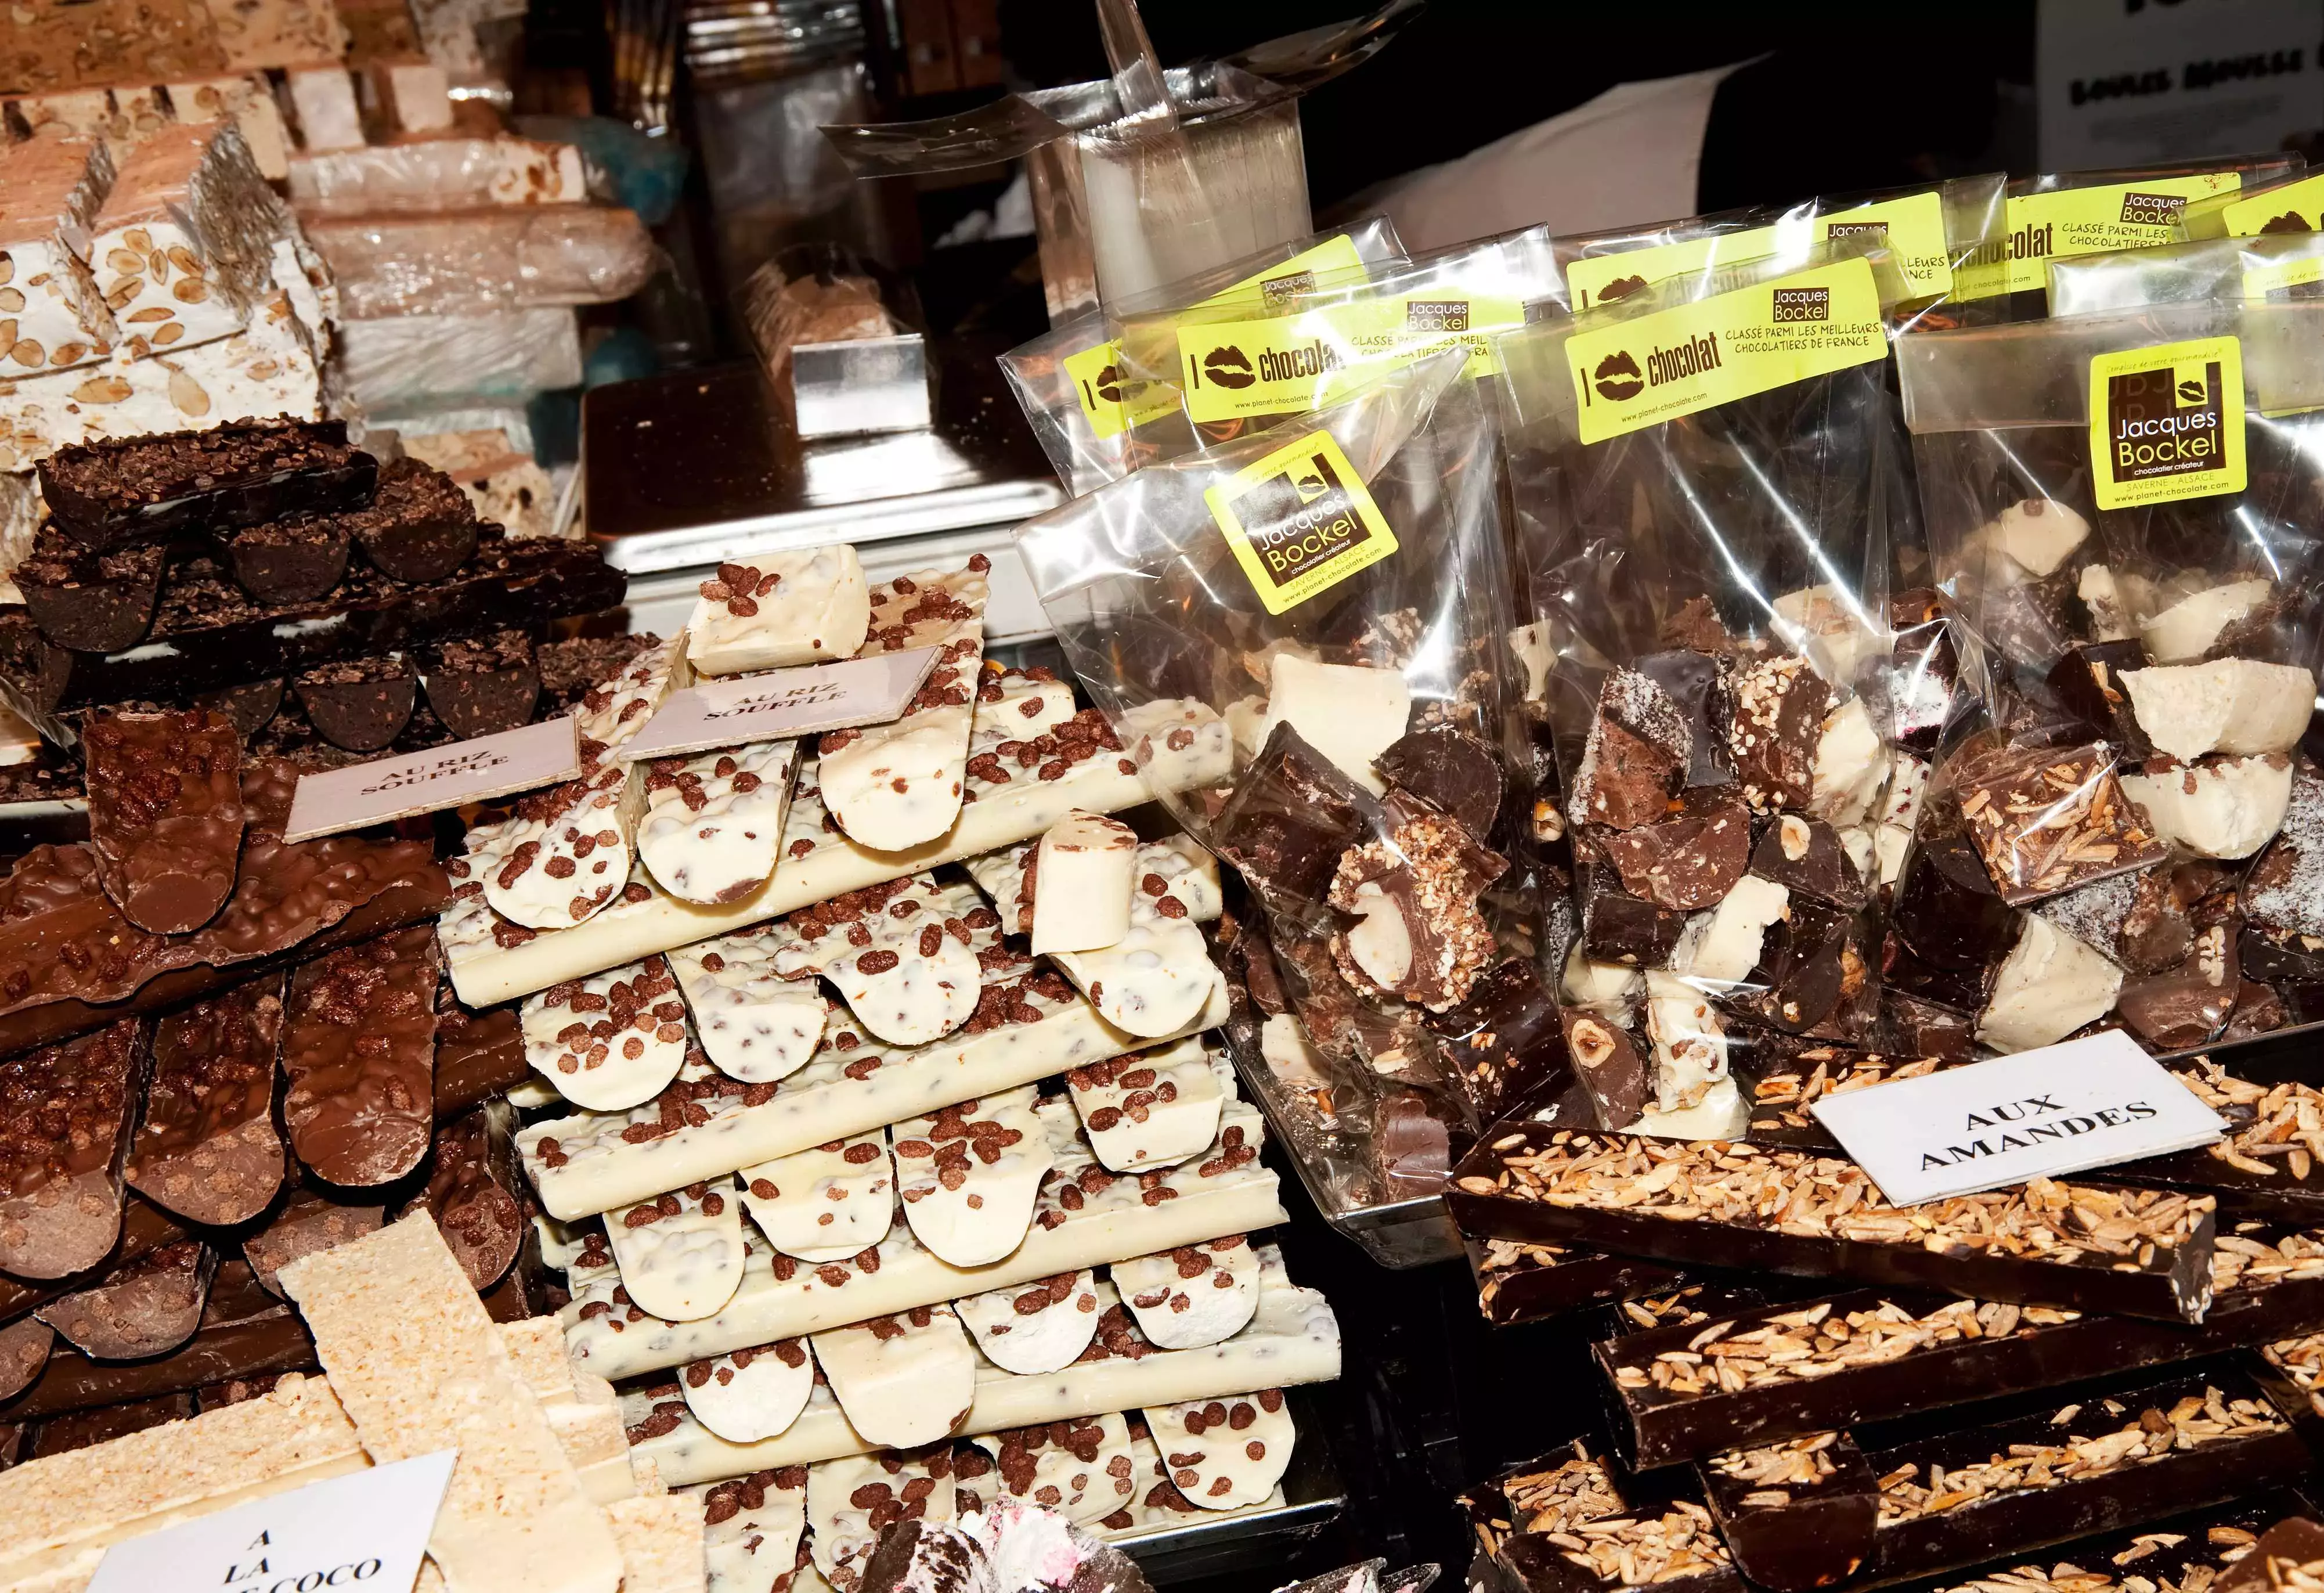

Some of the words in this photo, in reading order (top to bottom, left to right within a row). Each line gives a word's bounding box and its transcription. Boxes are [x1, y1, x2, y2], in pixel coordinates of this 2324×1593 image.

[2125, 193, 2185, 209] Jacques
[1829, 225, 1887, 237] Jacqus
[2062, 222, 2104, 234] CLASSÉ
[2108, 226, 2142, 236] PARMI
[2146, 229, 2167, 239] LES
[1908, 269, 1933, 279] NCE
[1775, 290, 1828, 304] Jacques
[1409, 303, 1467, 318] Jacques
[1409, 315, 1467, 330] Bockel
[1775, 302, 1827, 320] Bockel
[1460, 334, 1488, 345] MEIL
[1726, 325, 1762, 340] CLASSÉ
[1766, 326, 1793, 338] PARMI
[1799, 325, 1817, 336] LES
[1820, 322, 1879, 334] MEILLEURS
[1735, 339, 1807, 353] CHOCOLATIERS
[1811, 338, 1823, 348] DE
[1827, 336, 1870, 349] FRANCE
[1259, 339, 1347, 383] chocola
[1647, 331, 1722, 387] chocolat
[1235, 391, 1329, 409] www.planet-chocolate.cm
[1621, 392, 1708, 423] www.planet-chocolate.com
[2117, 412, 2217, 439] Jacques
[2119, 430, 2217, 467] Bockel
[2134, 464, 2173, 476] chocolatier
[2174, 460, 2204, 470] créateur
[2114, 482, 2229, 503] www.planet-chocolate.com
[2127, 478, 2168, 492] SAVERNE
[2178, 473, 2214, 485] ALSACE
[1262, 495, 1347, 550] Jacques
[1267, 510, 1358, 572] Bockel
[1290, 565, 1327, 590] SAVERNE
[1334, 544, 1366, 568] ALSACE
[1291, 553, 1326, 575] chocolatier
[1326, 539, 1351, 556] créateur
[1283, 547, 1382, 604] www.planet-chocolate.com
[703, 691, 847, 720] SOUFFLE
[733, 692, 777, 706] AU
[785, 682, 840, 697] RIZ
[360, 756, 509, 795] SOUFFLE
[381, 765, 426, 781] AU
[436, 751, 492, 769] RIZ
[1966, 1093, 2068, 1131] AUX
[1920, 1100, 2159, 1172] AMANDES
[246, 1529, 273, 1551] A
[222, 1557, 270, 1585] LA
[269, 1558, 382, 1593] COCO
